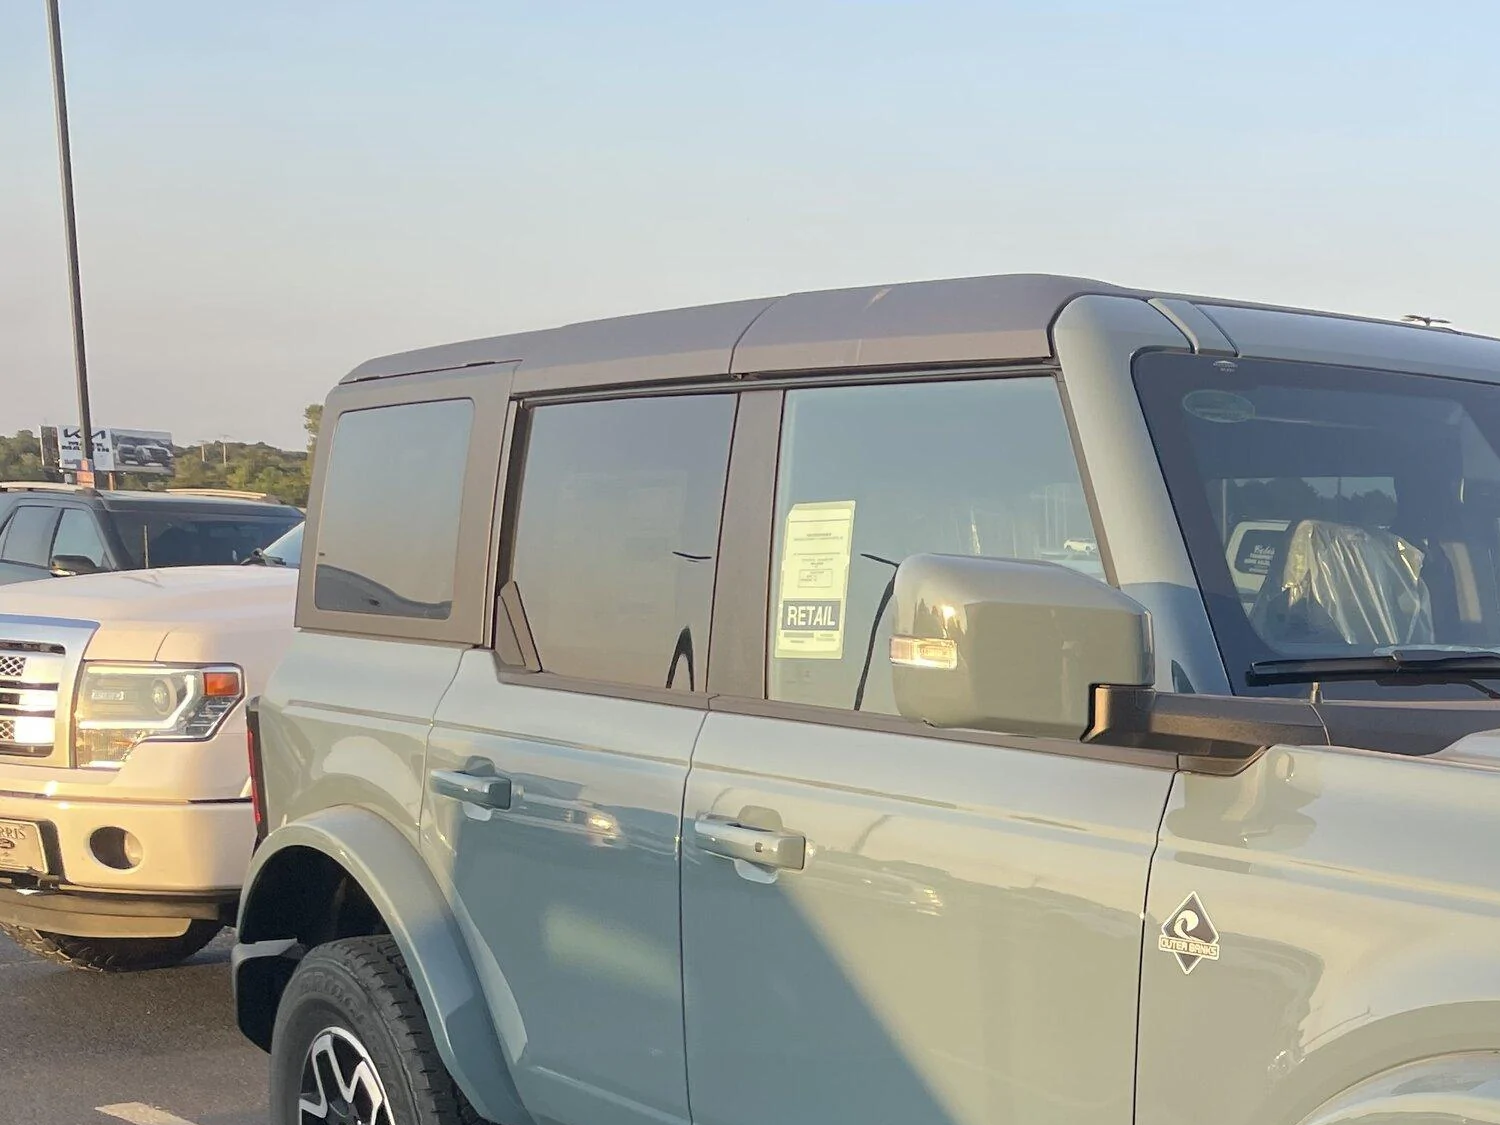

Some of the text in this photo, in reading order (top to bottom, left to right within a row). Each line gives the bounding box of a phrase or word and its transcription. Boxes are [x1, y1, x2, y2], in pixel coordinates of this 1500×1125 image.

[787, 605, 836, 626] RETAIL
[1161, 938, 1217, 956] OUTER BANKS
